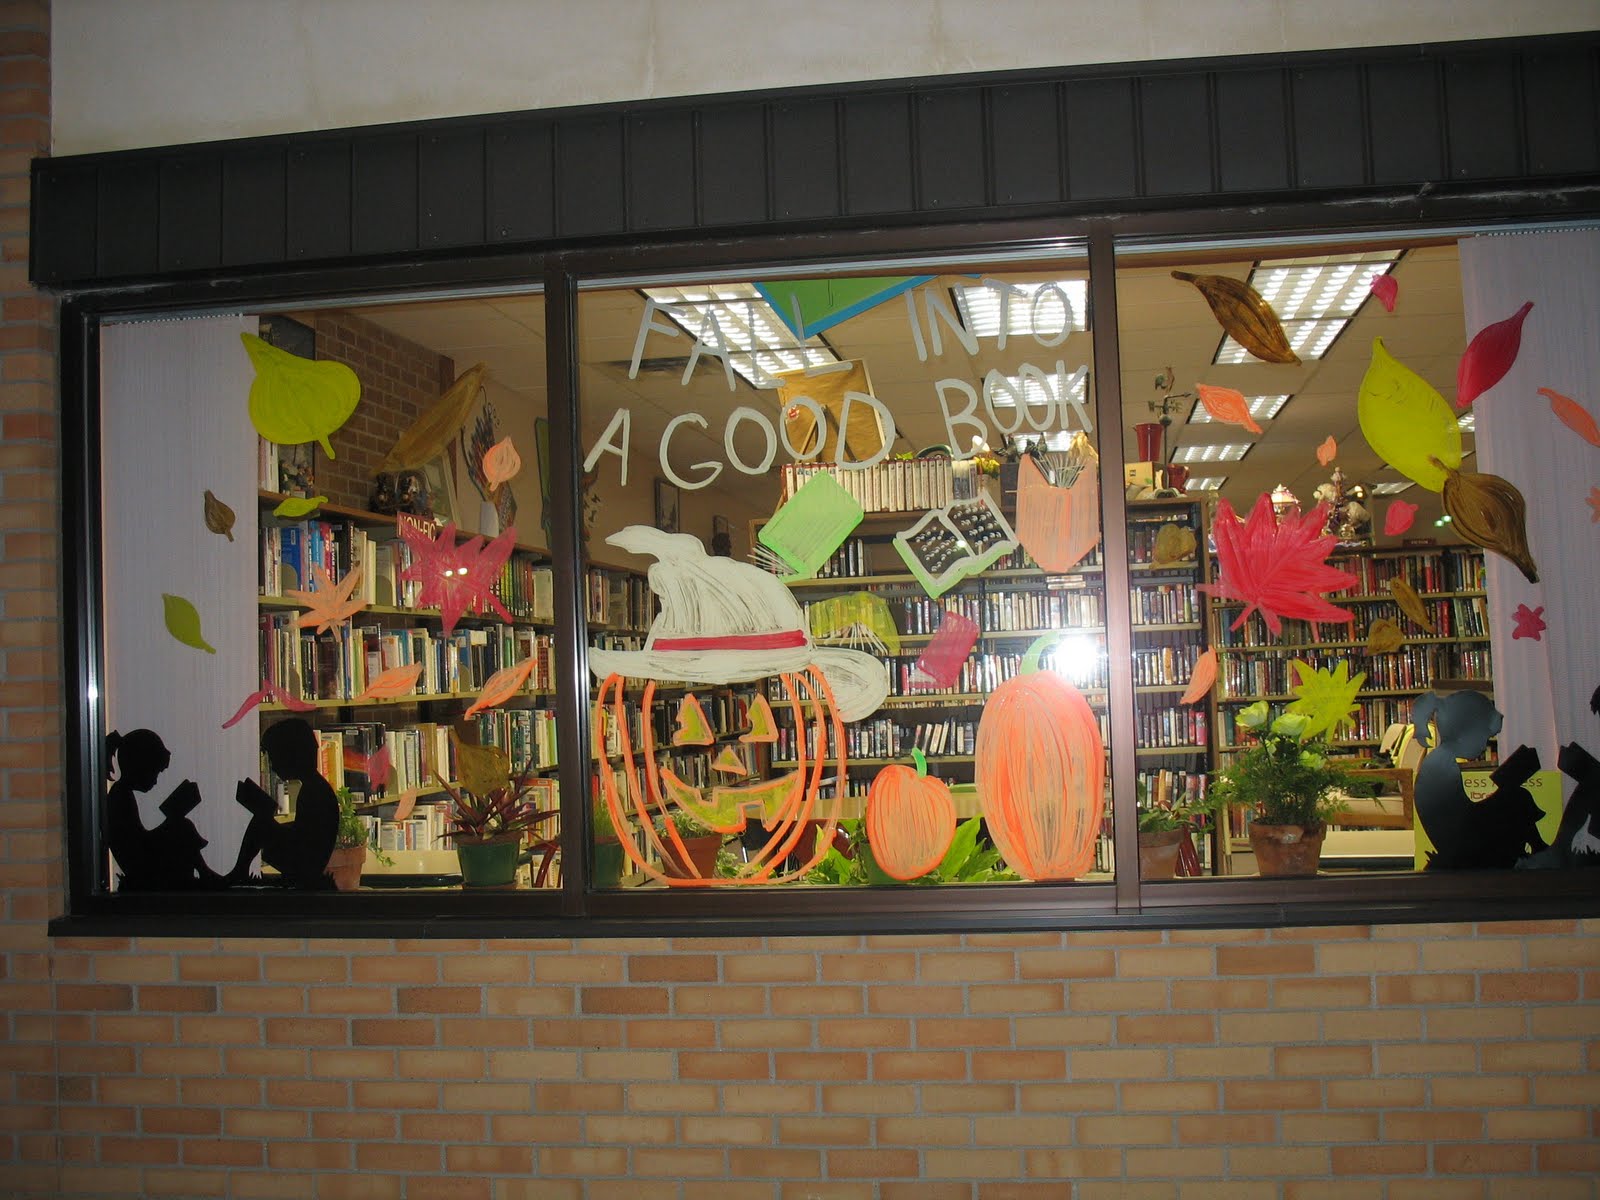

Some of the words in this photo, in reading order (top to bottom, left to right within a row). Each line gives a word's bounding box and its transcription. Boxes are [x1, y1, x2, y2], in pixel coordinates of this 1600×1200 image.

[628, 292, 853, 391] FALL
[904, 278, 1074, 362] INTO
[584, 407, 631, 487] A
[659, 390, 896, 490] GOOD
[935, 359, 1093, 462] BOOK
